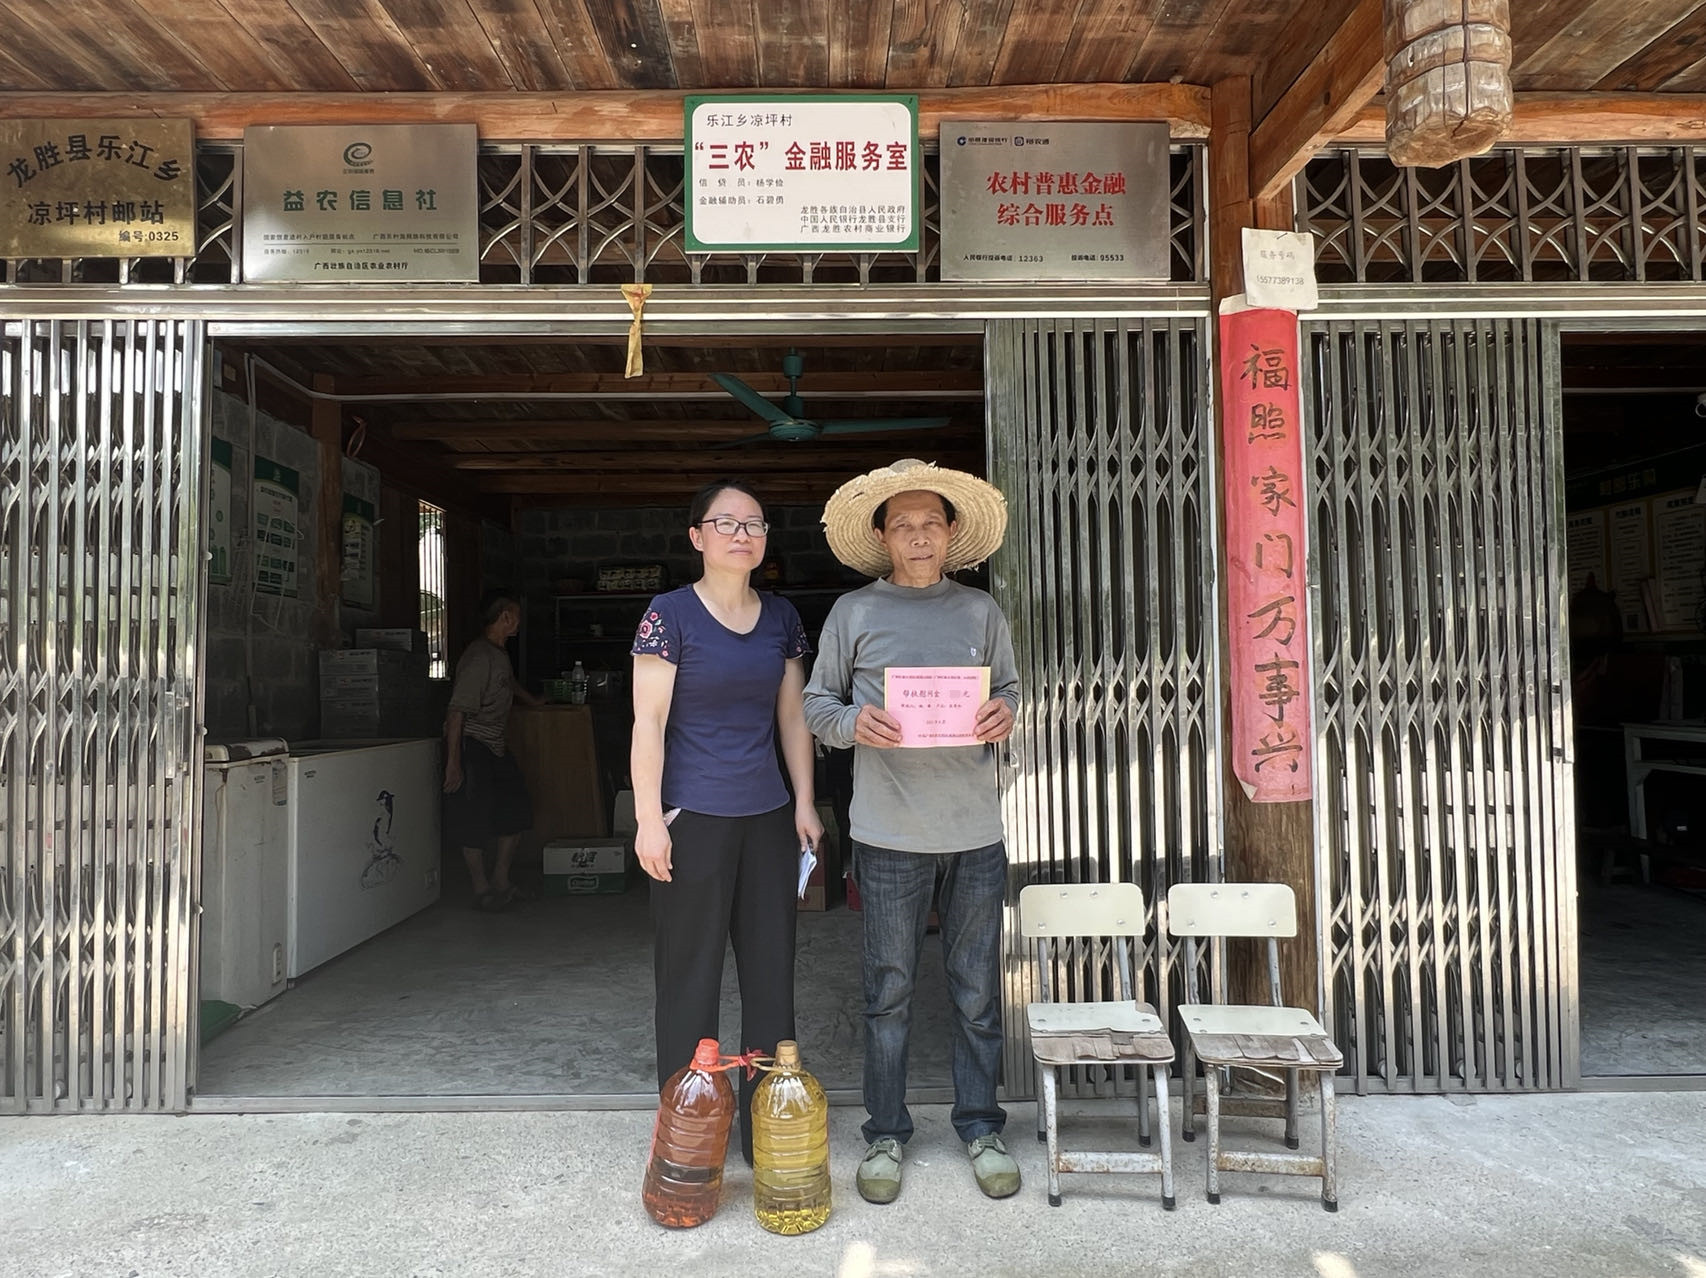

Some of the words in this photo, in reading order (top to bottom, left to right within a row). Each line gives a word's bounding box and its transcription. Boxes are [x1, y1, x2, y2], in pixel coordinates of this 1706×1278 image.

[706, 114, 793, 127] 乐江乡凉坪村
[7, 134, 181, 188] 龙胜县乐江乡
[986, 172, 1127, 195] 农村普惠金融
[283, 189, 437, 212] 益农信息社
[800, 205, 906, 214] 龙胜各族自治县人民政府
[28, 201, 164, 225] 凉坪村邮站
[800, 215, 906, 224] 中国人民银行龙胜县支行
[997, 203, 1115, 226] 综合服务点
[800, 225, 906, 233] 广西龙胜农村商业银行
[314, 262, 409, 271] 广西壮族自治区农业农村厅
[1240, 343, 1303, 773] 福照家门万事兴
